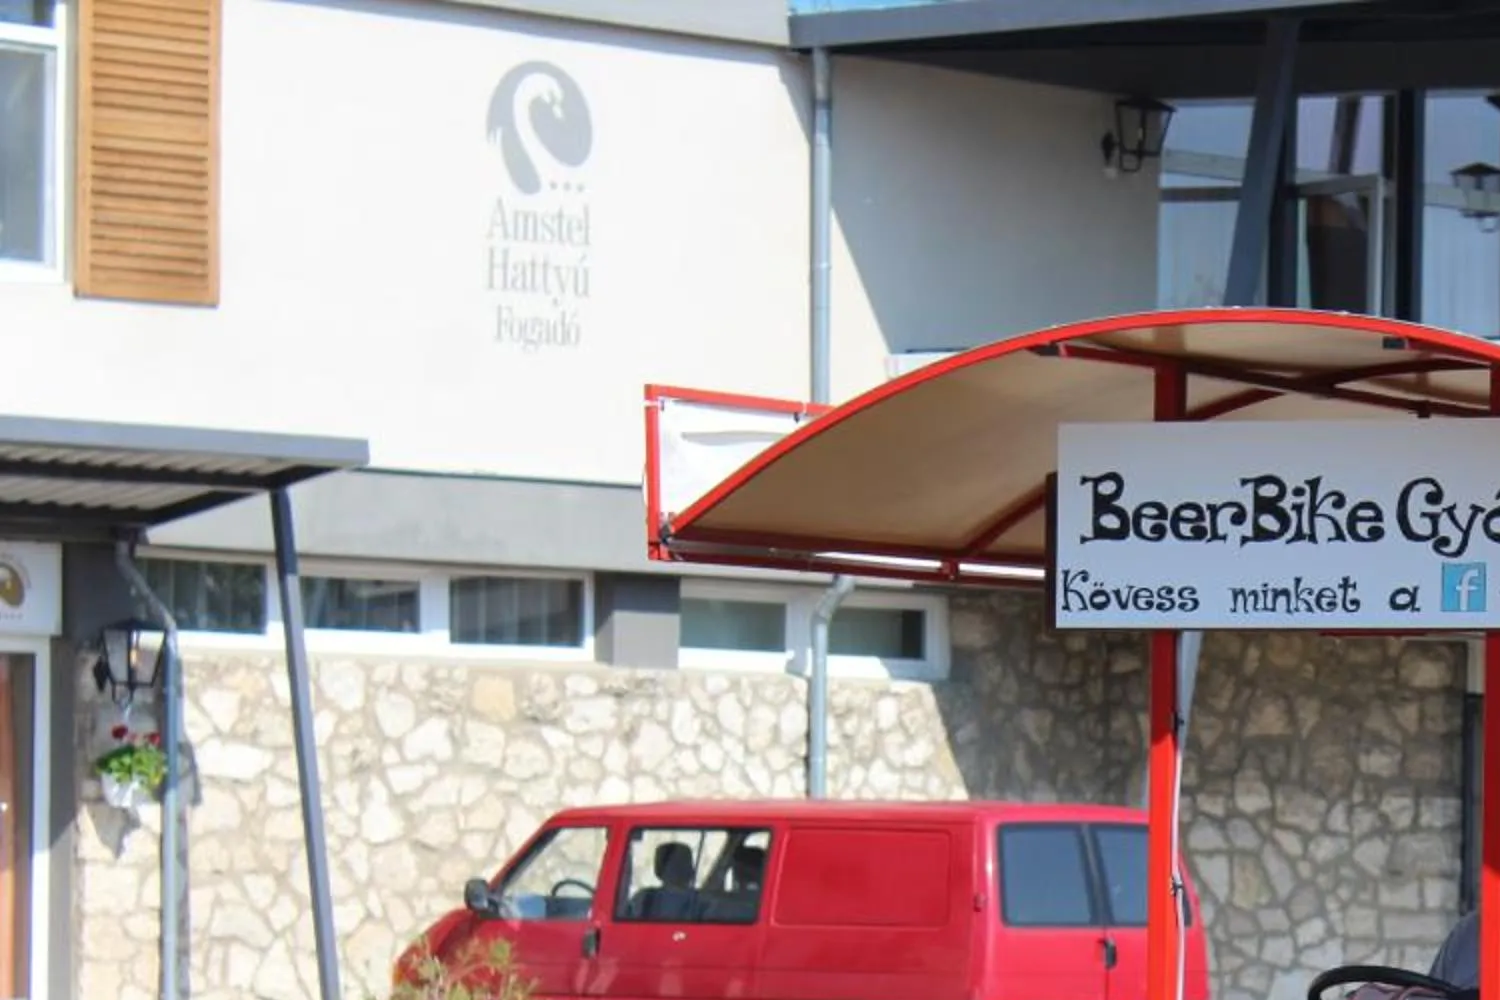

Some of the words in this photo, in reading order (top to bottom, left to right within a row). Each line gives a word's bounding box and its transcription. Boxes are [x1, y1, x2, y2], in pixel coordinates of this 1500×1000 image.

[485, 196, 592, 247] Amstel
[486, 246, 592, 307] Hattyú
[494, 304, 582, 353] Fogadó
[1061, 568, 1200, 613] Kövess
[1228, 576, 1361, 614] minket
[1388, 584, 1421, 613] a
